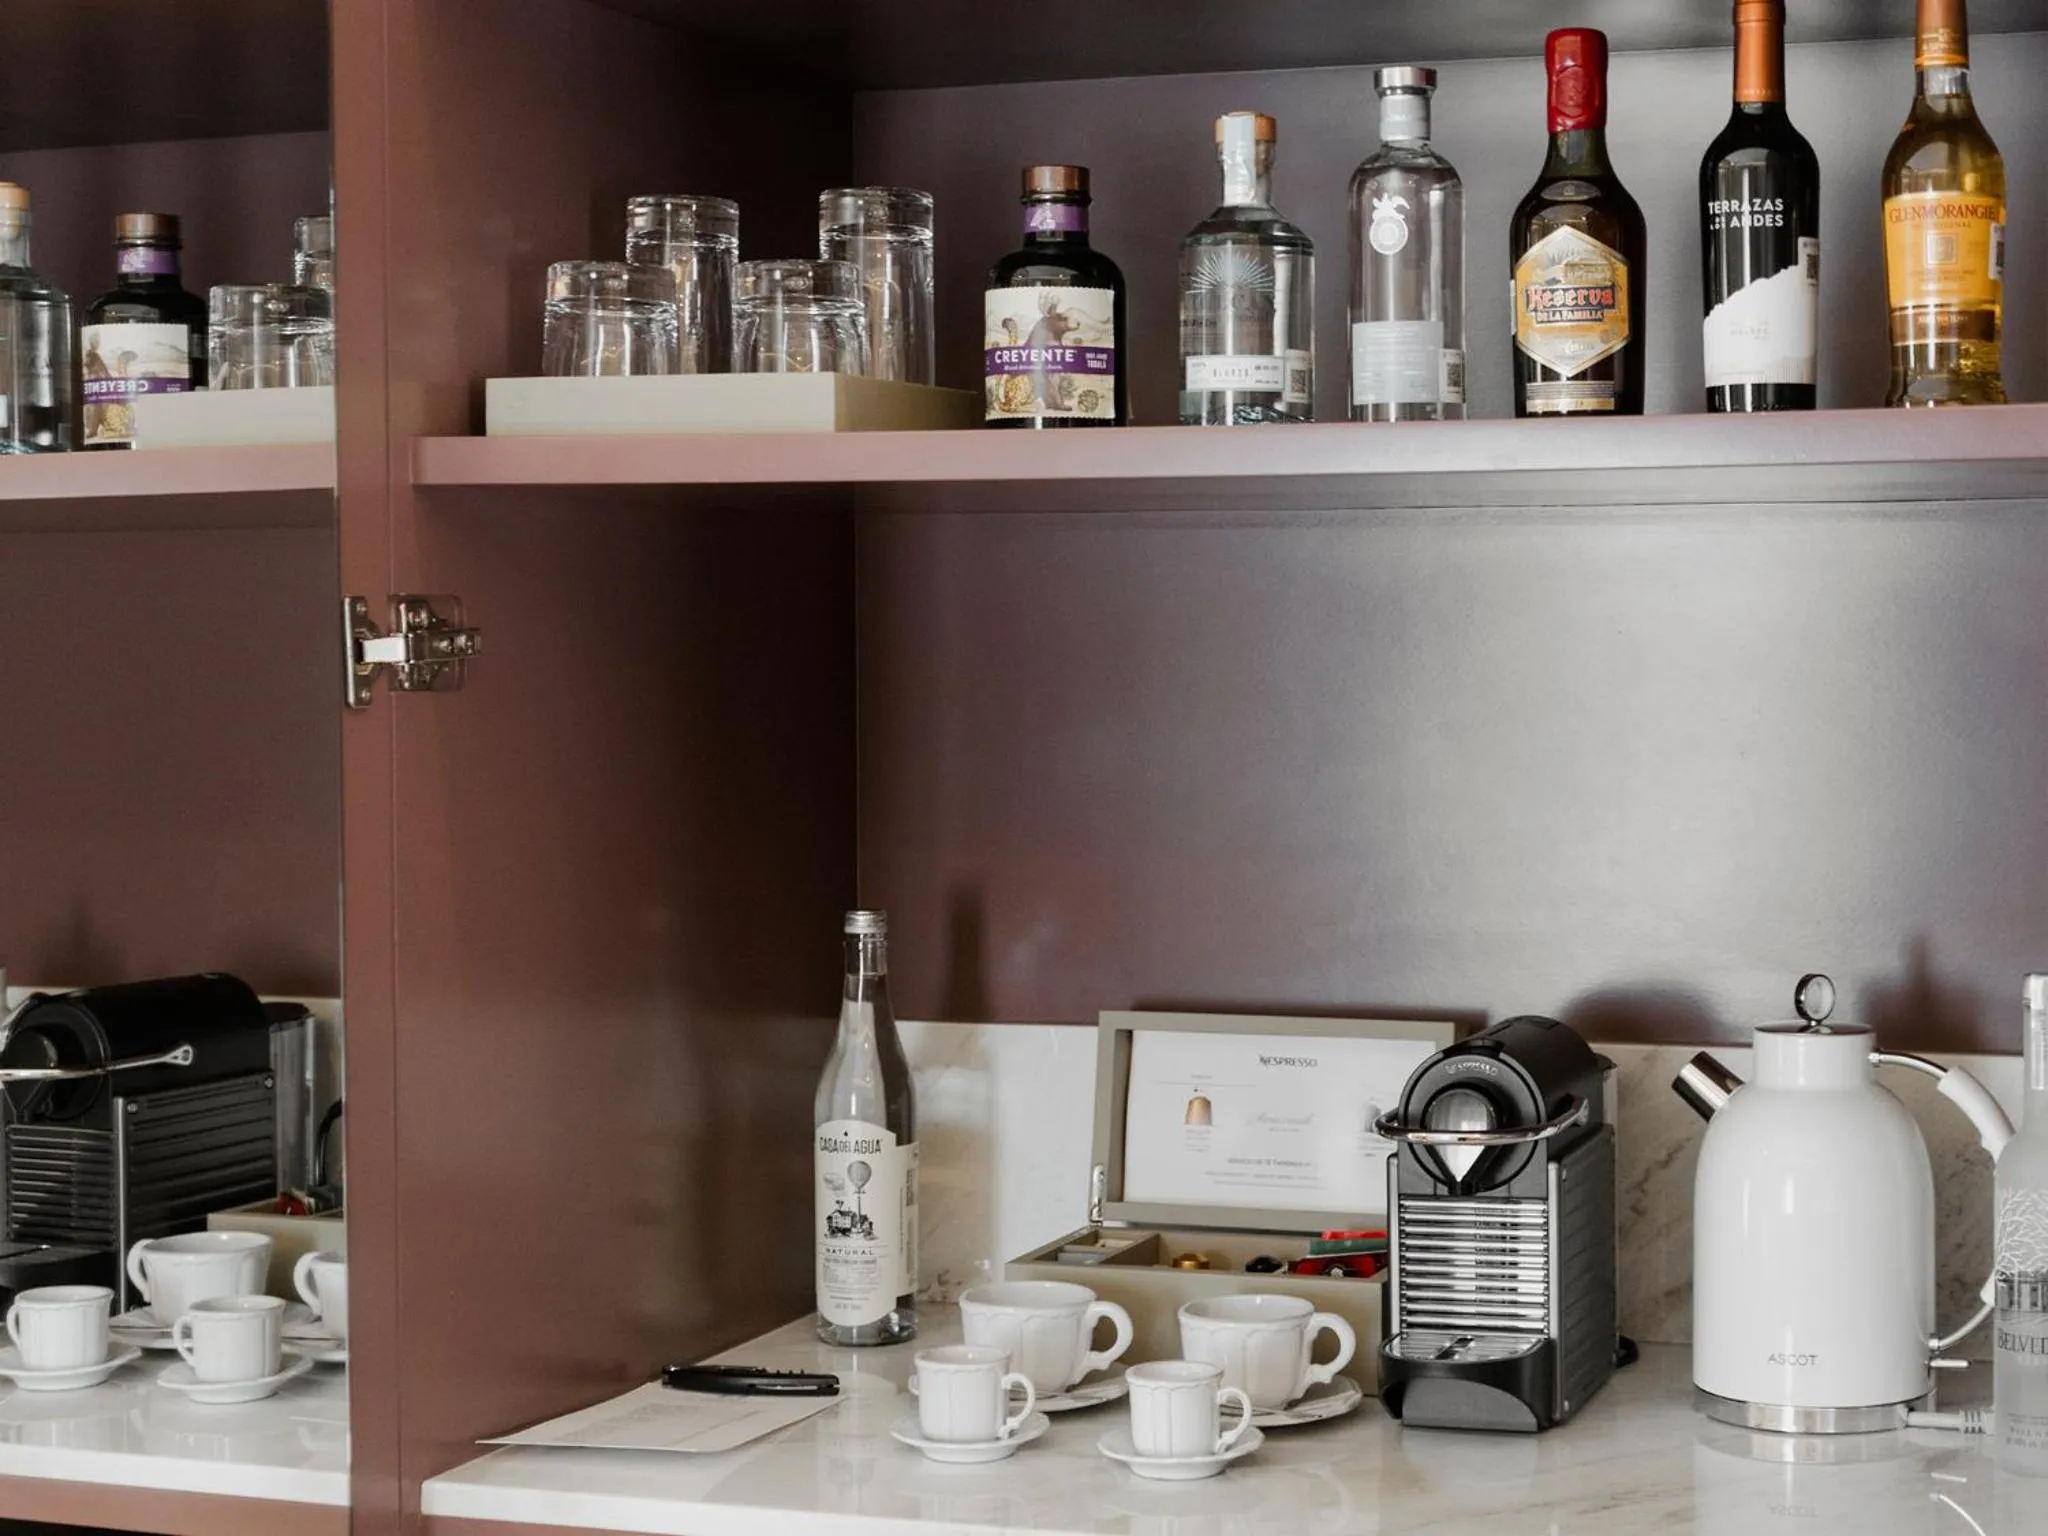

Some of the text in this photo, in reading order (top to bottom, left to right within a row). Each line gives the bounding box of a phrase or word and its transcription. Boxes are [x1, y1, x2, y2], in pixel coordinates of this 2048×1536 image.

[1707, 198, 1784, 215] TERRAZAS
[1888, 202, 2000, 225] GLENMORANGIE
[1729, 213, 1784, 229] ANDES
[1527, 287, 1613, 312] Reserva
[994, 348, 1076, 364] CREYENTE
[1258, 1054, 1318, 1068] NESPRESSO
[819, 1135, 838, 1154] CASA
[853, 1138, 883, 1155] AGUA
[825, 1247, 876, 1257] NATURAL
[1767, 1352, 1818, 1367] ASCOT
